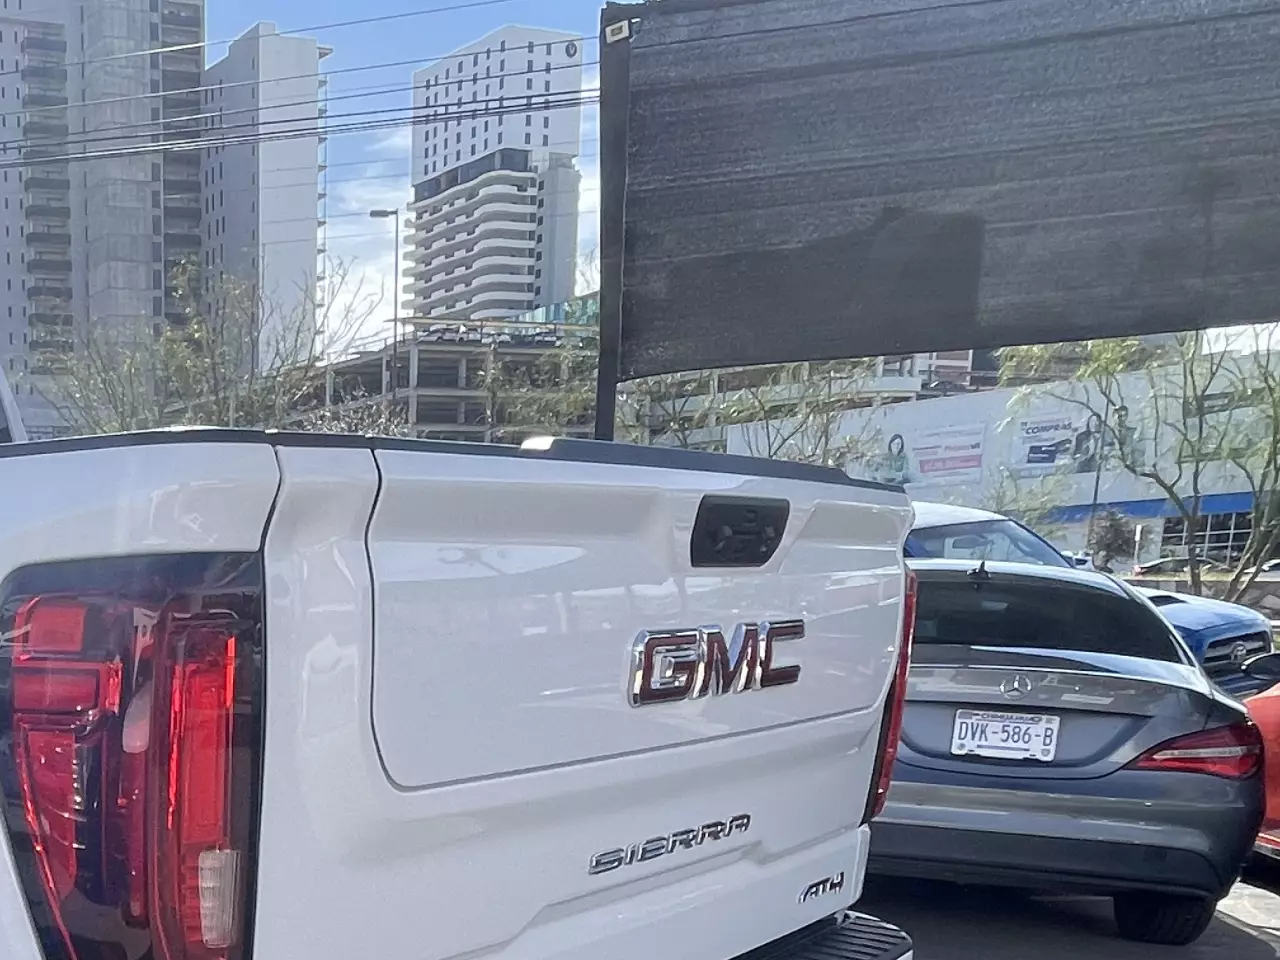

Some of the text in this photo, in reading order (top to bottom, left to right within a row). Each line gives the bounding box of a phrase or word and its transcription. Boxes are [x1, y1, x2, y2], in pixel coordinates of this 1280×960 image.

[628, 619, 806, 708] GMC
[958, 721, 1054, 747] DVK-586-B
[588, 813, 751, 875] SIERRA
[798, 871, 844, 904] AT4
